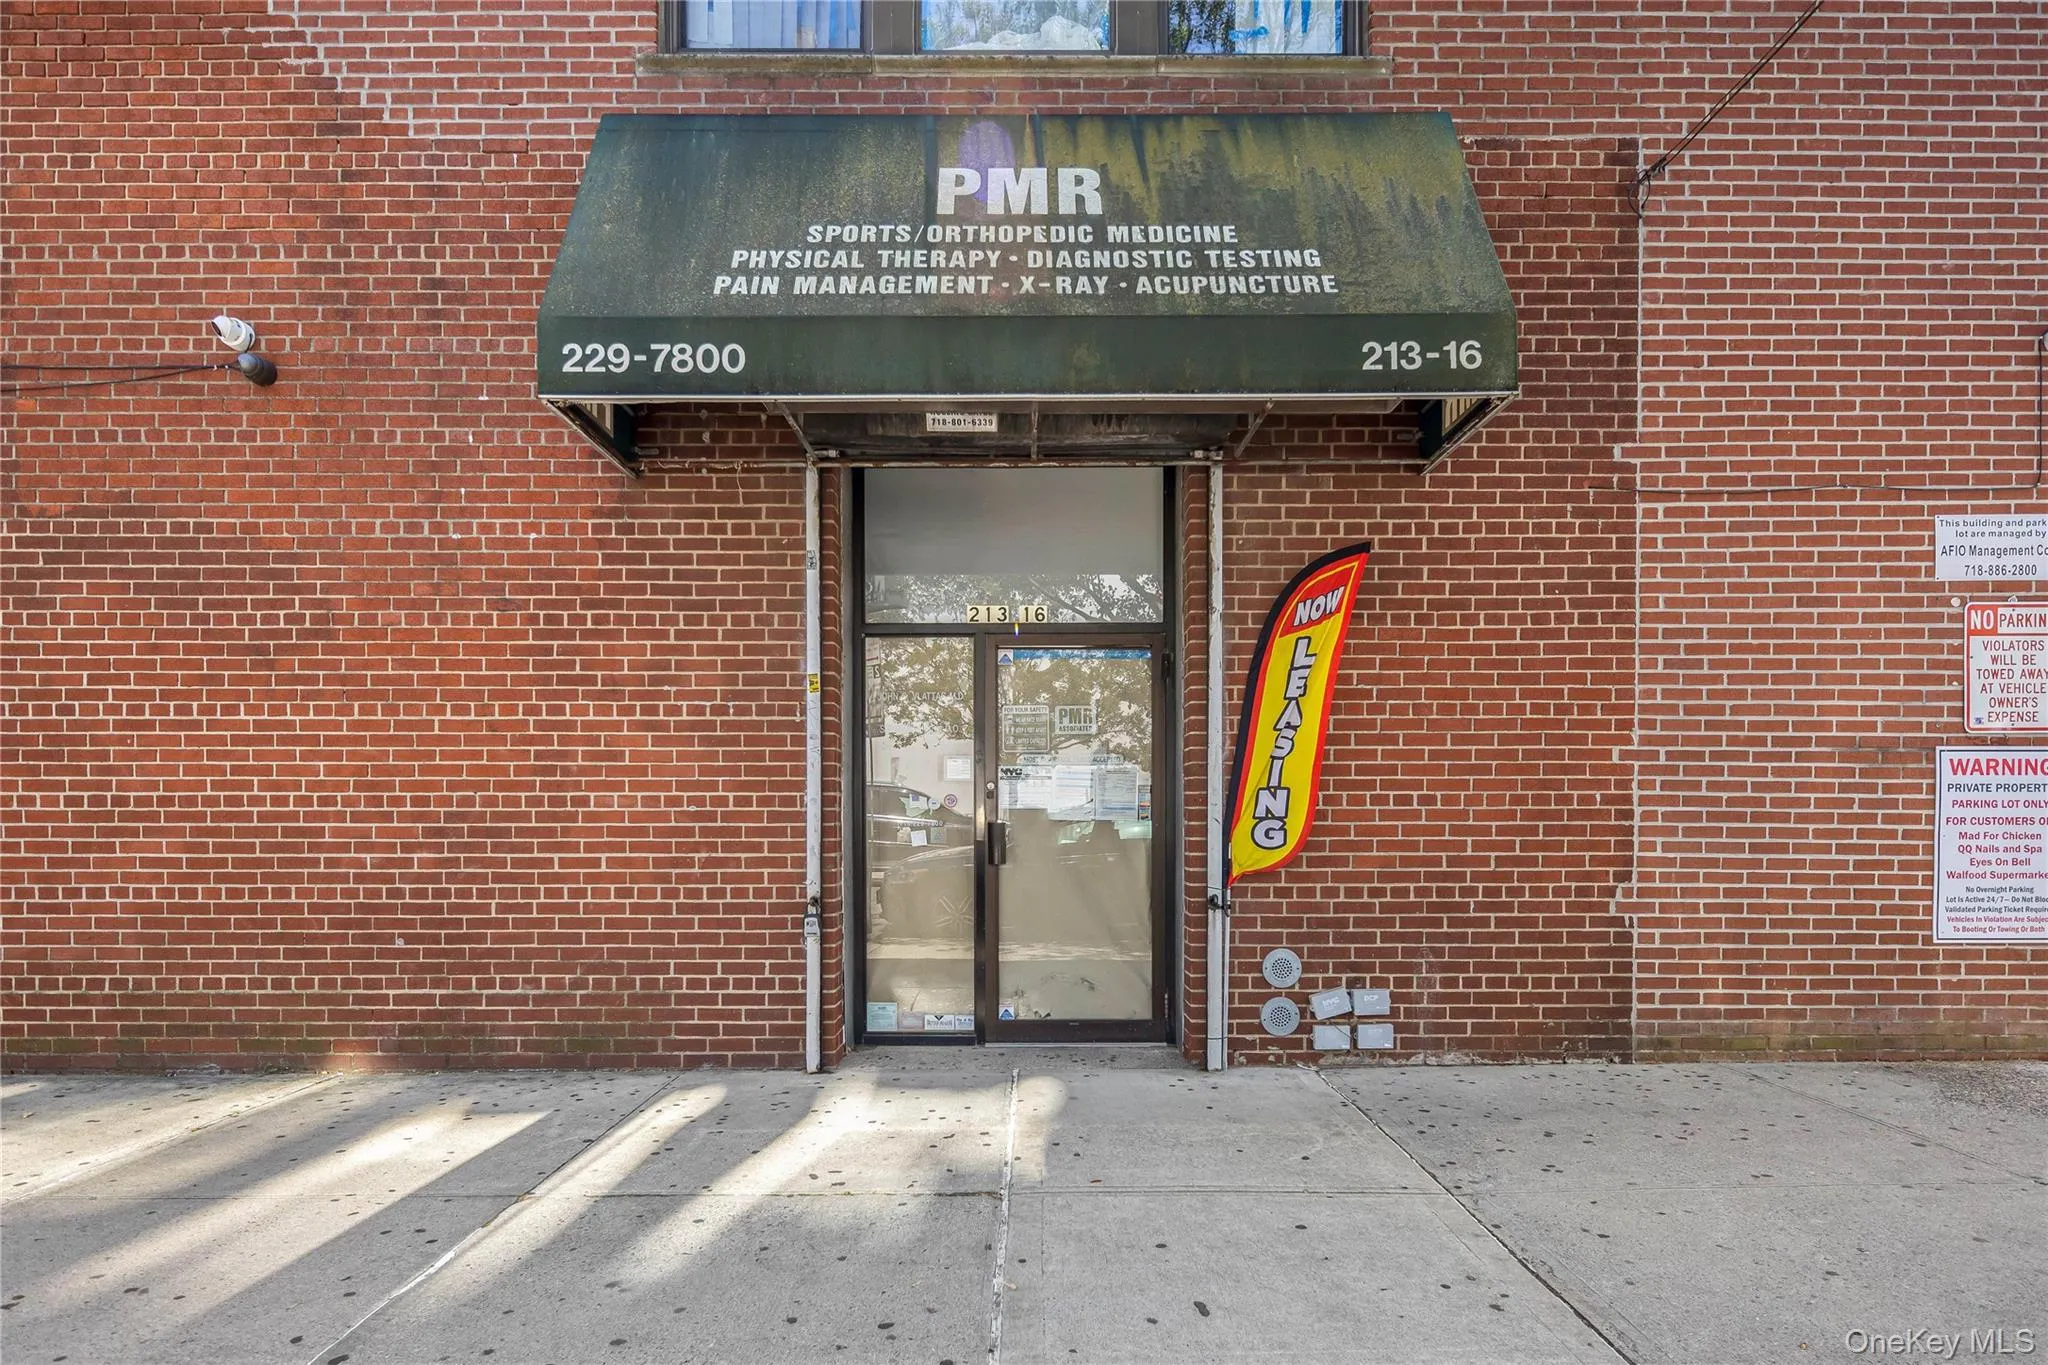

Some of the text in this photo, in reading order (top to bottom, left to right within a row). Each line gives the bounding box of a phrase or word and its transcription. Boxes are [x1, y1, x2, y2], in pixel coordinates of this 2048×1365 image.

[936, 167, 1104, 215] PMR
[806, 225, 1239, 244] SPORTS/ORTHOPEDIC MEDICINE
[731, 249, 1322, 269] PHYSICAL THERAPY DIAGNOSTIC TESTING
[712, 275, 1339, 295] PAIN MANAGEMENT X-RAY ACUPUNCTURE
[562, 342, 746, 374] 229-7800
[1361, 340, 1483, 371] 213-16
[931, 417, 993, 427] 718-801-6339
[1939, 519, 1960, 527] This
[1963, 519, 2003, 529] building
[2005, 519, 2024, 527] and
[1955, 530, 1968, 538] lot
[1988, 530, 2033, 540] managed
[2035, 530, 2047, 540] by
[1941, 545, 1967, 556] AFIO
[1969, 545, 2035, 558] Management
[1964, 564, 2038, 576] 718-886-2800
[1293, 585, 1345, 628] NOW
[969, 606, 1046, 622] 213 16
[1970, 609, 2047, 630] NO PARKIN
[1982, 640, 2045, 651] VIOLATORS
[1990, 655, 2037, 666] WILL BE
[1976, 668, 2048, 680] TOWED AWAY
[1980, 683, 2047, 694] AT VEHICLE
[1989, 697, 2039, 709] OWNER'S
[1059, 708, 1093, 724] PMR
[1987, 711, 2039, 723] EXPENSE
[1251, 635, 1318, 850] LEASING
[1949, 758, 2048, 776] WARNING
[1947, 783, 1993, 793] PRIVATE
[1952, 800, 2048, 809] PARKING LOT ONLY
[1945, 816, 1967, 826] FOR
[1970, 816, 2036, 826] CUSTOMERS
[1958, 831, 2042, 840] Mad For Chicken
[1957, 845, 2043, 856] QQ Nails and Spa
[1969, 858, 2031, 868] Eyes On Bell
[1946, 871, 1987, 880] Walfood
[1976, 886, 2007, 895] Overnight
[2009, 886, 2034, 894] Parking
[1977, 906, 2003, 914] Parking
[1961, 926, 1987, 934] Booting
[1997, 926, 2019, 934] Towing
